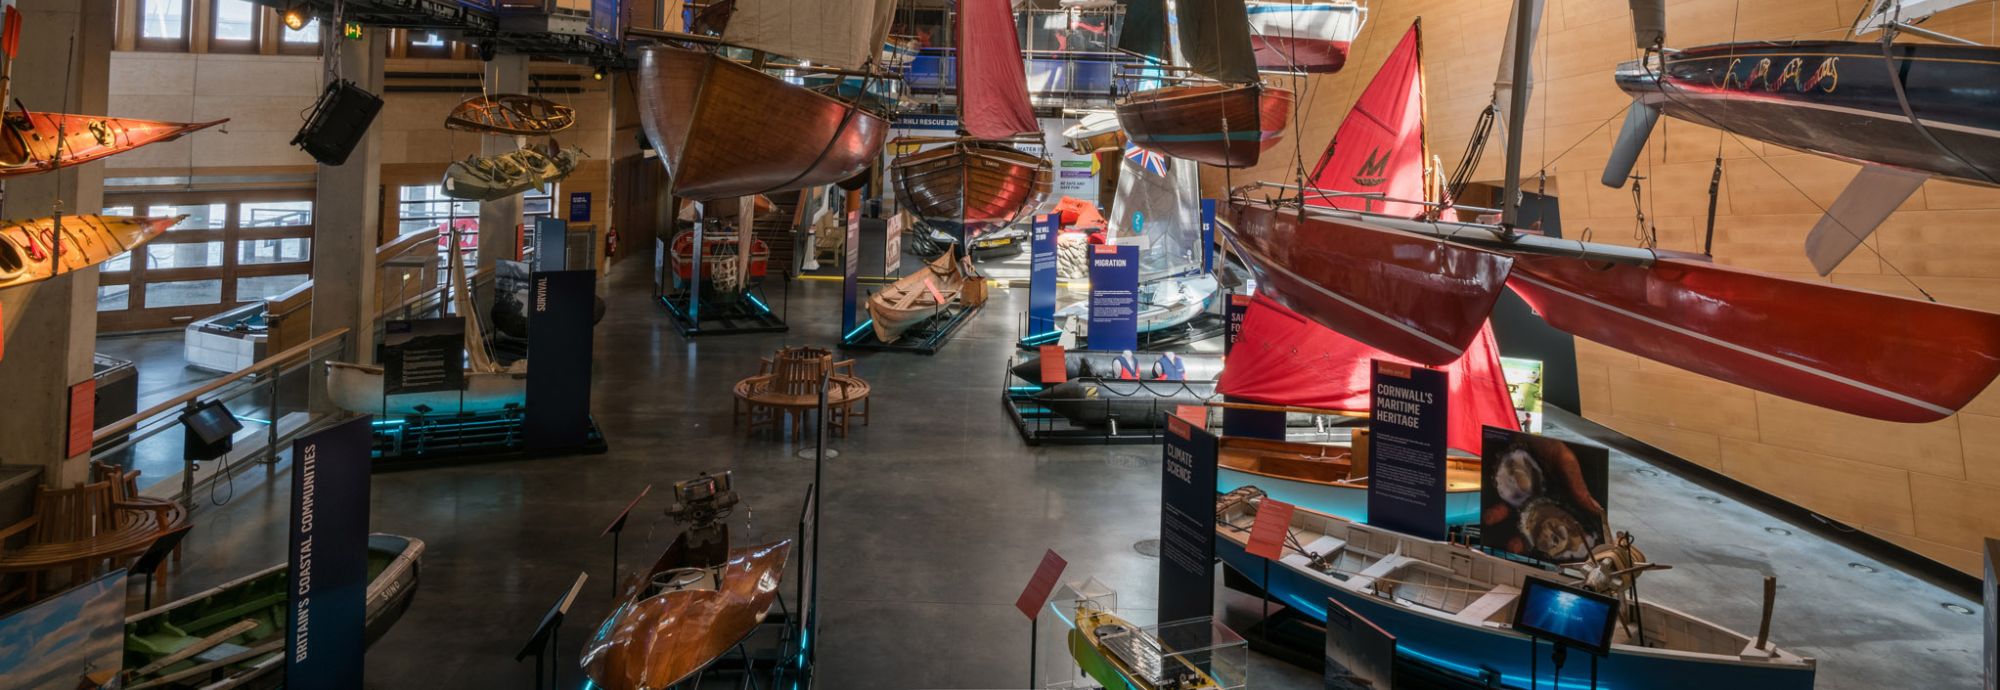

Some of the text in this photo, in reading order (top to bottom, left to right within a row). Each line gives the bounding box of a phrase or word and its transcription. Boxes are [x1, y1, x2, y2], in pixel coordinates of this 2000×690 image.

[919, 118, 945, 126] RESCUE
[946, 119, 959, 127] ZON
[1094, 259, 1127, 268] MIGRATION
[537, 276, 547, 311] SURVIVAL
[1377, 383, 1433, 404] CORNWALL'S
[1377, 397, 1420, 416] MARITIME
[1376, 409, 1419, 429] HERITAGE
[1167, 443, 1193, 468] CLIMATE
[1167, 459, 1192, 484] SCIENCE
[296, 443, 316, 663] BRITAIN'S COASTAL COMMUNITIES
